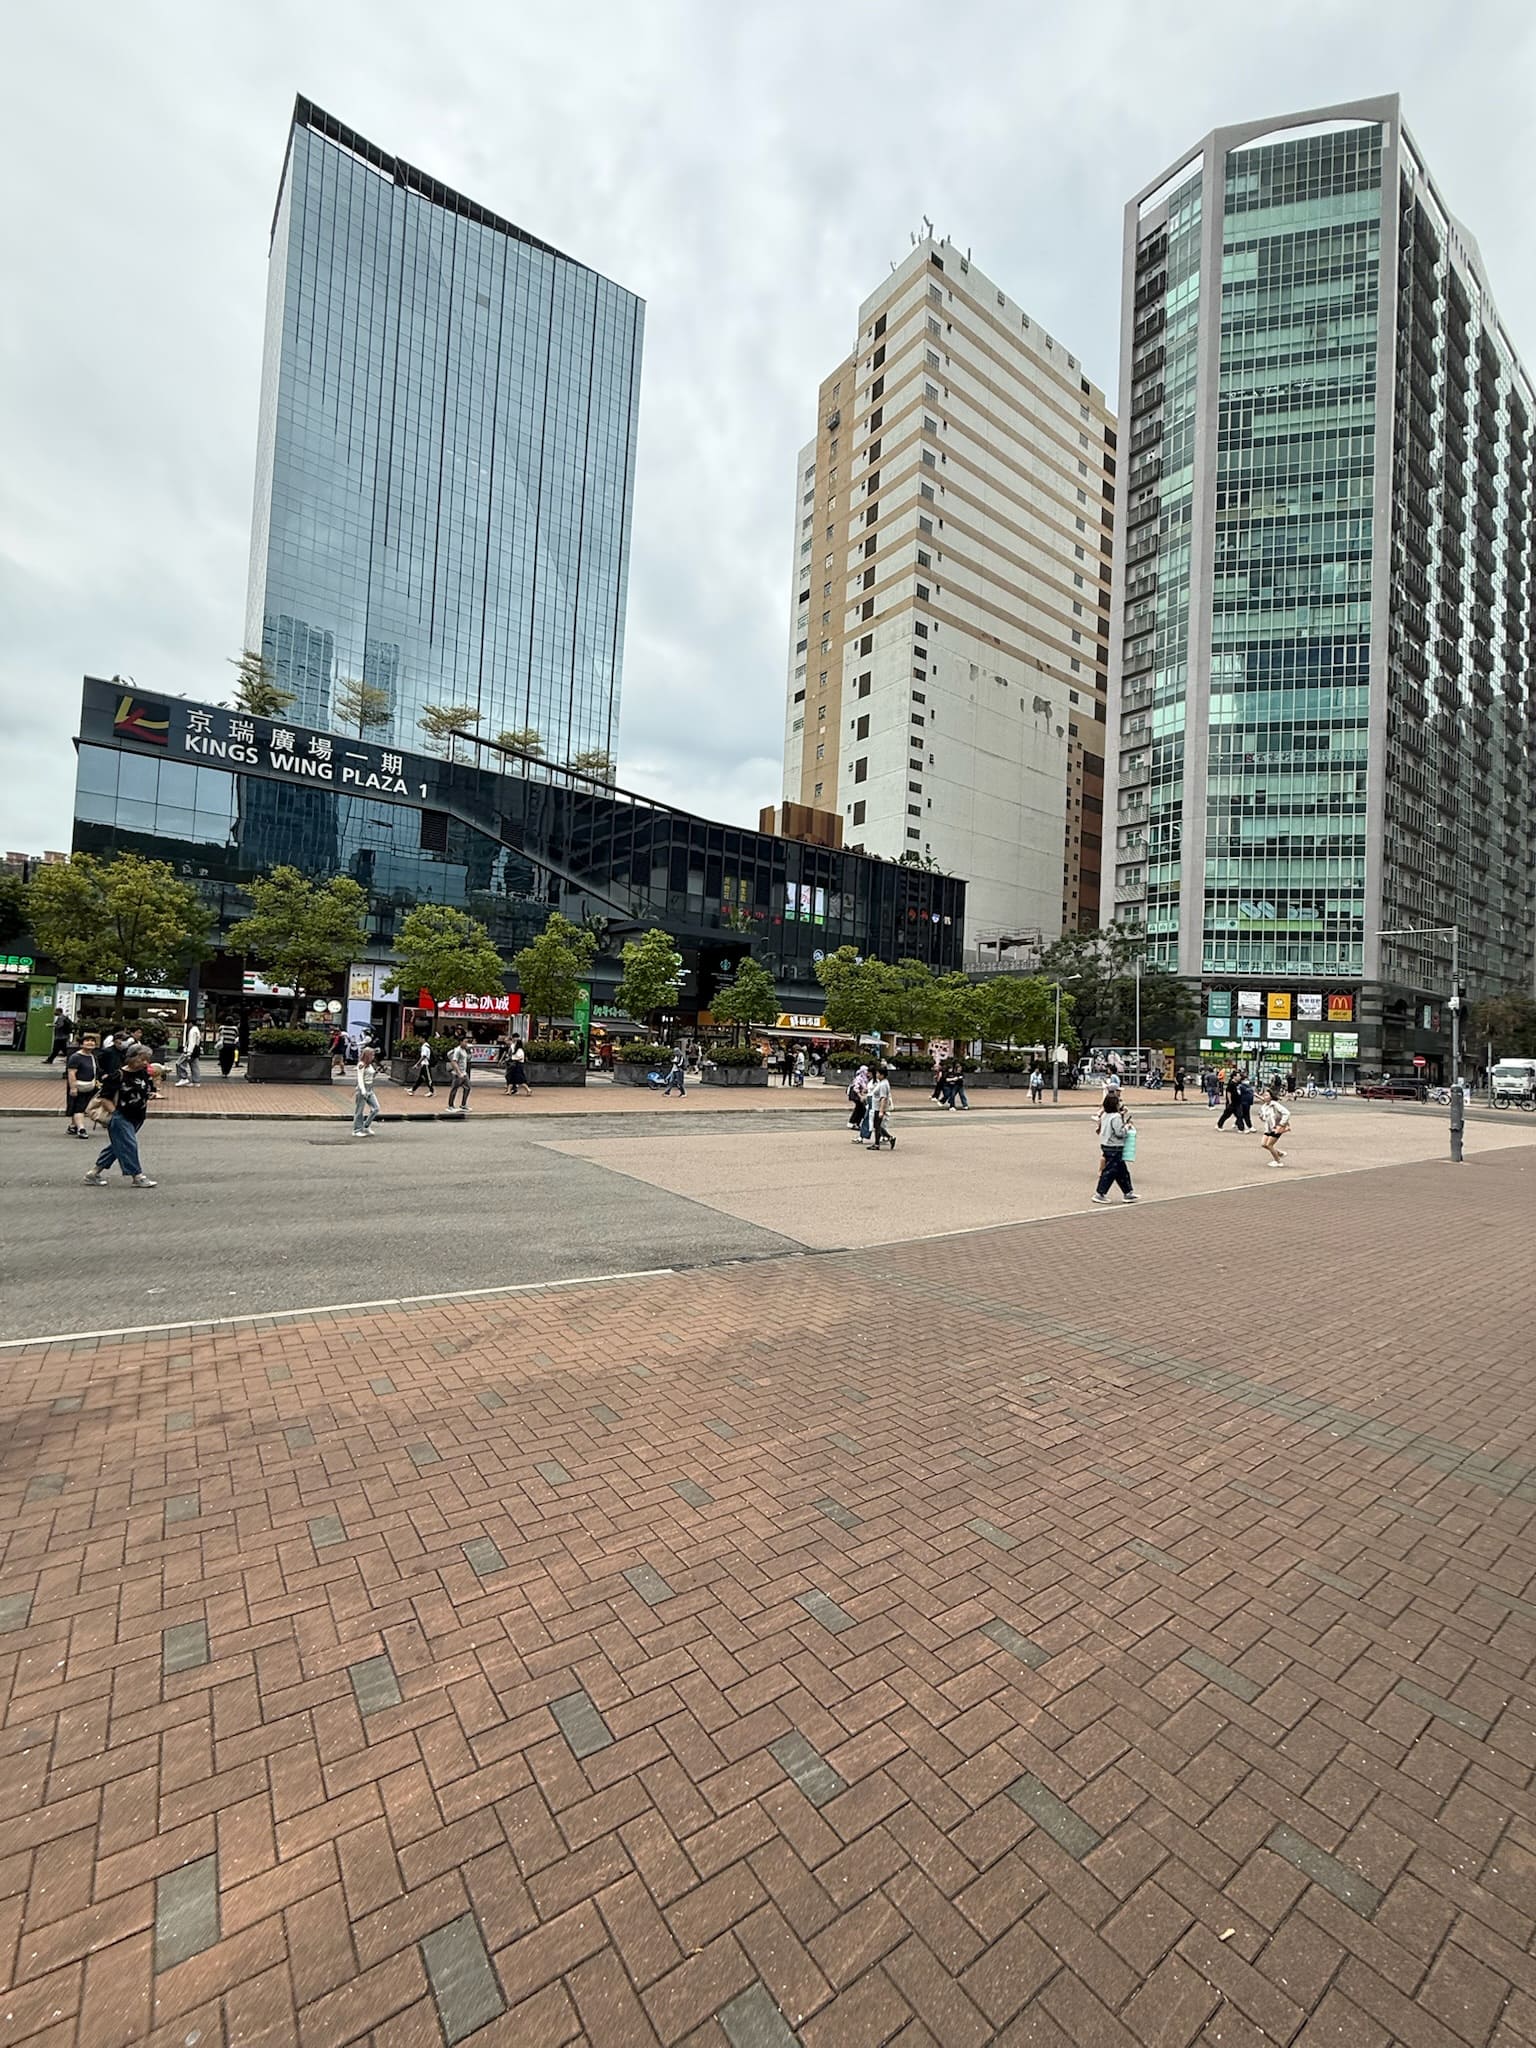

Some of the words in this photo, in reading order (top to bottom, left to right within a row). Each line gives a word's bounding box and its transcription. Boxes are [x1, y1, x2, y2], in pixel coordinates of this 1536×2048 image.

[184, 734, 259, 764] KINGS
[269, 751, 334, 780] WING
[342, 767, 409, 796] PLAZA
[419, 783, 428, 799] 1
[186, 709, 403, 776] 京瑞廣場一期
